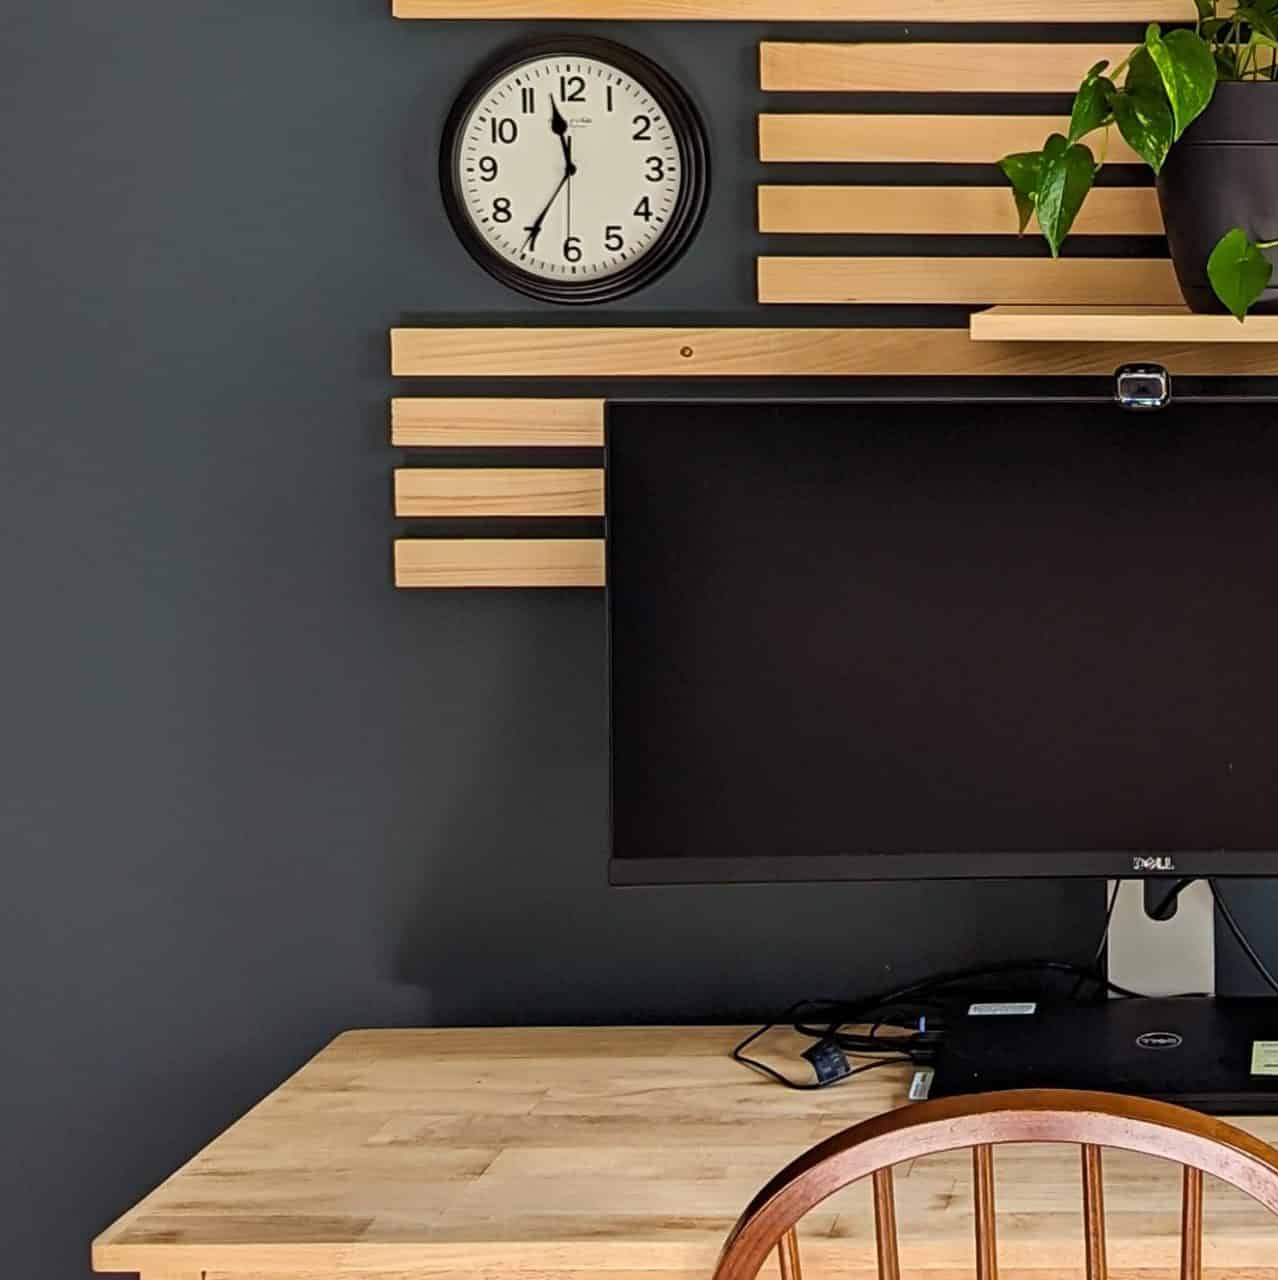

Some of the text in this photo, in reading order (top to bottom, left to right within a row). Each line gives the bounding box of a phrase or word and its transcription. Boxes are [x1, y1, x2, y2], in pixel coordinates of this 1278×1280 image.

[521, 87, 535, 114] 11
[559, 76, 586, 102] 12
[606, 85, 613, 112] 1
[491, 117, 518, 144] 10
[632, 114, 652, 141] 2
[478, 155, 498, 182] 9
[645, 156, 665, 182] 3
[492, 197, 513, 224] 8
[633, 196, 653, 222] 4
[523, 226, 542, 252] 7
[563, 236, 582, 263] 6
[604, 225, 624, 252] 5
[1132, 855, 1175, 871] DELL
